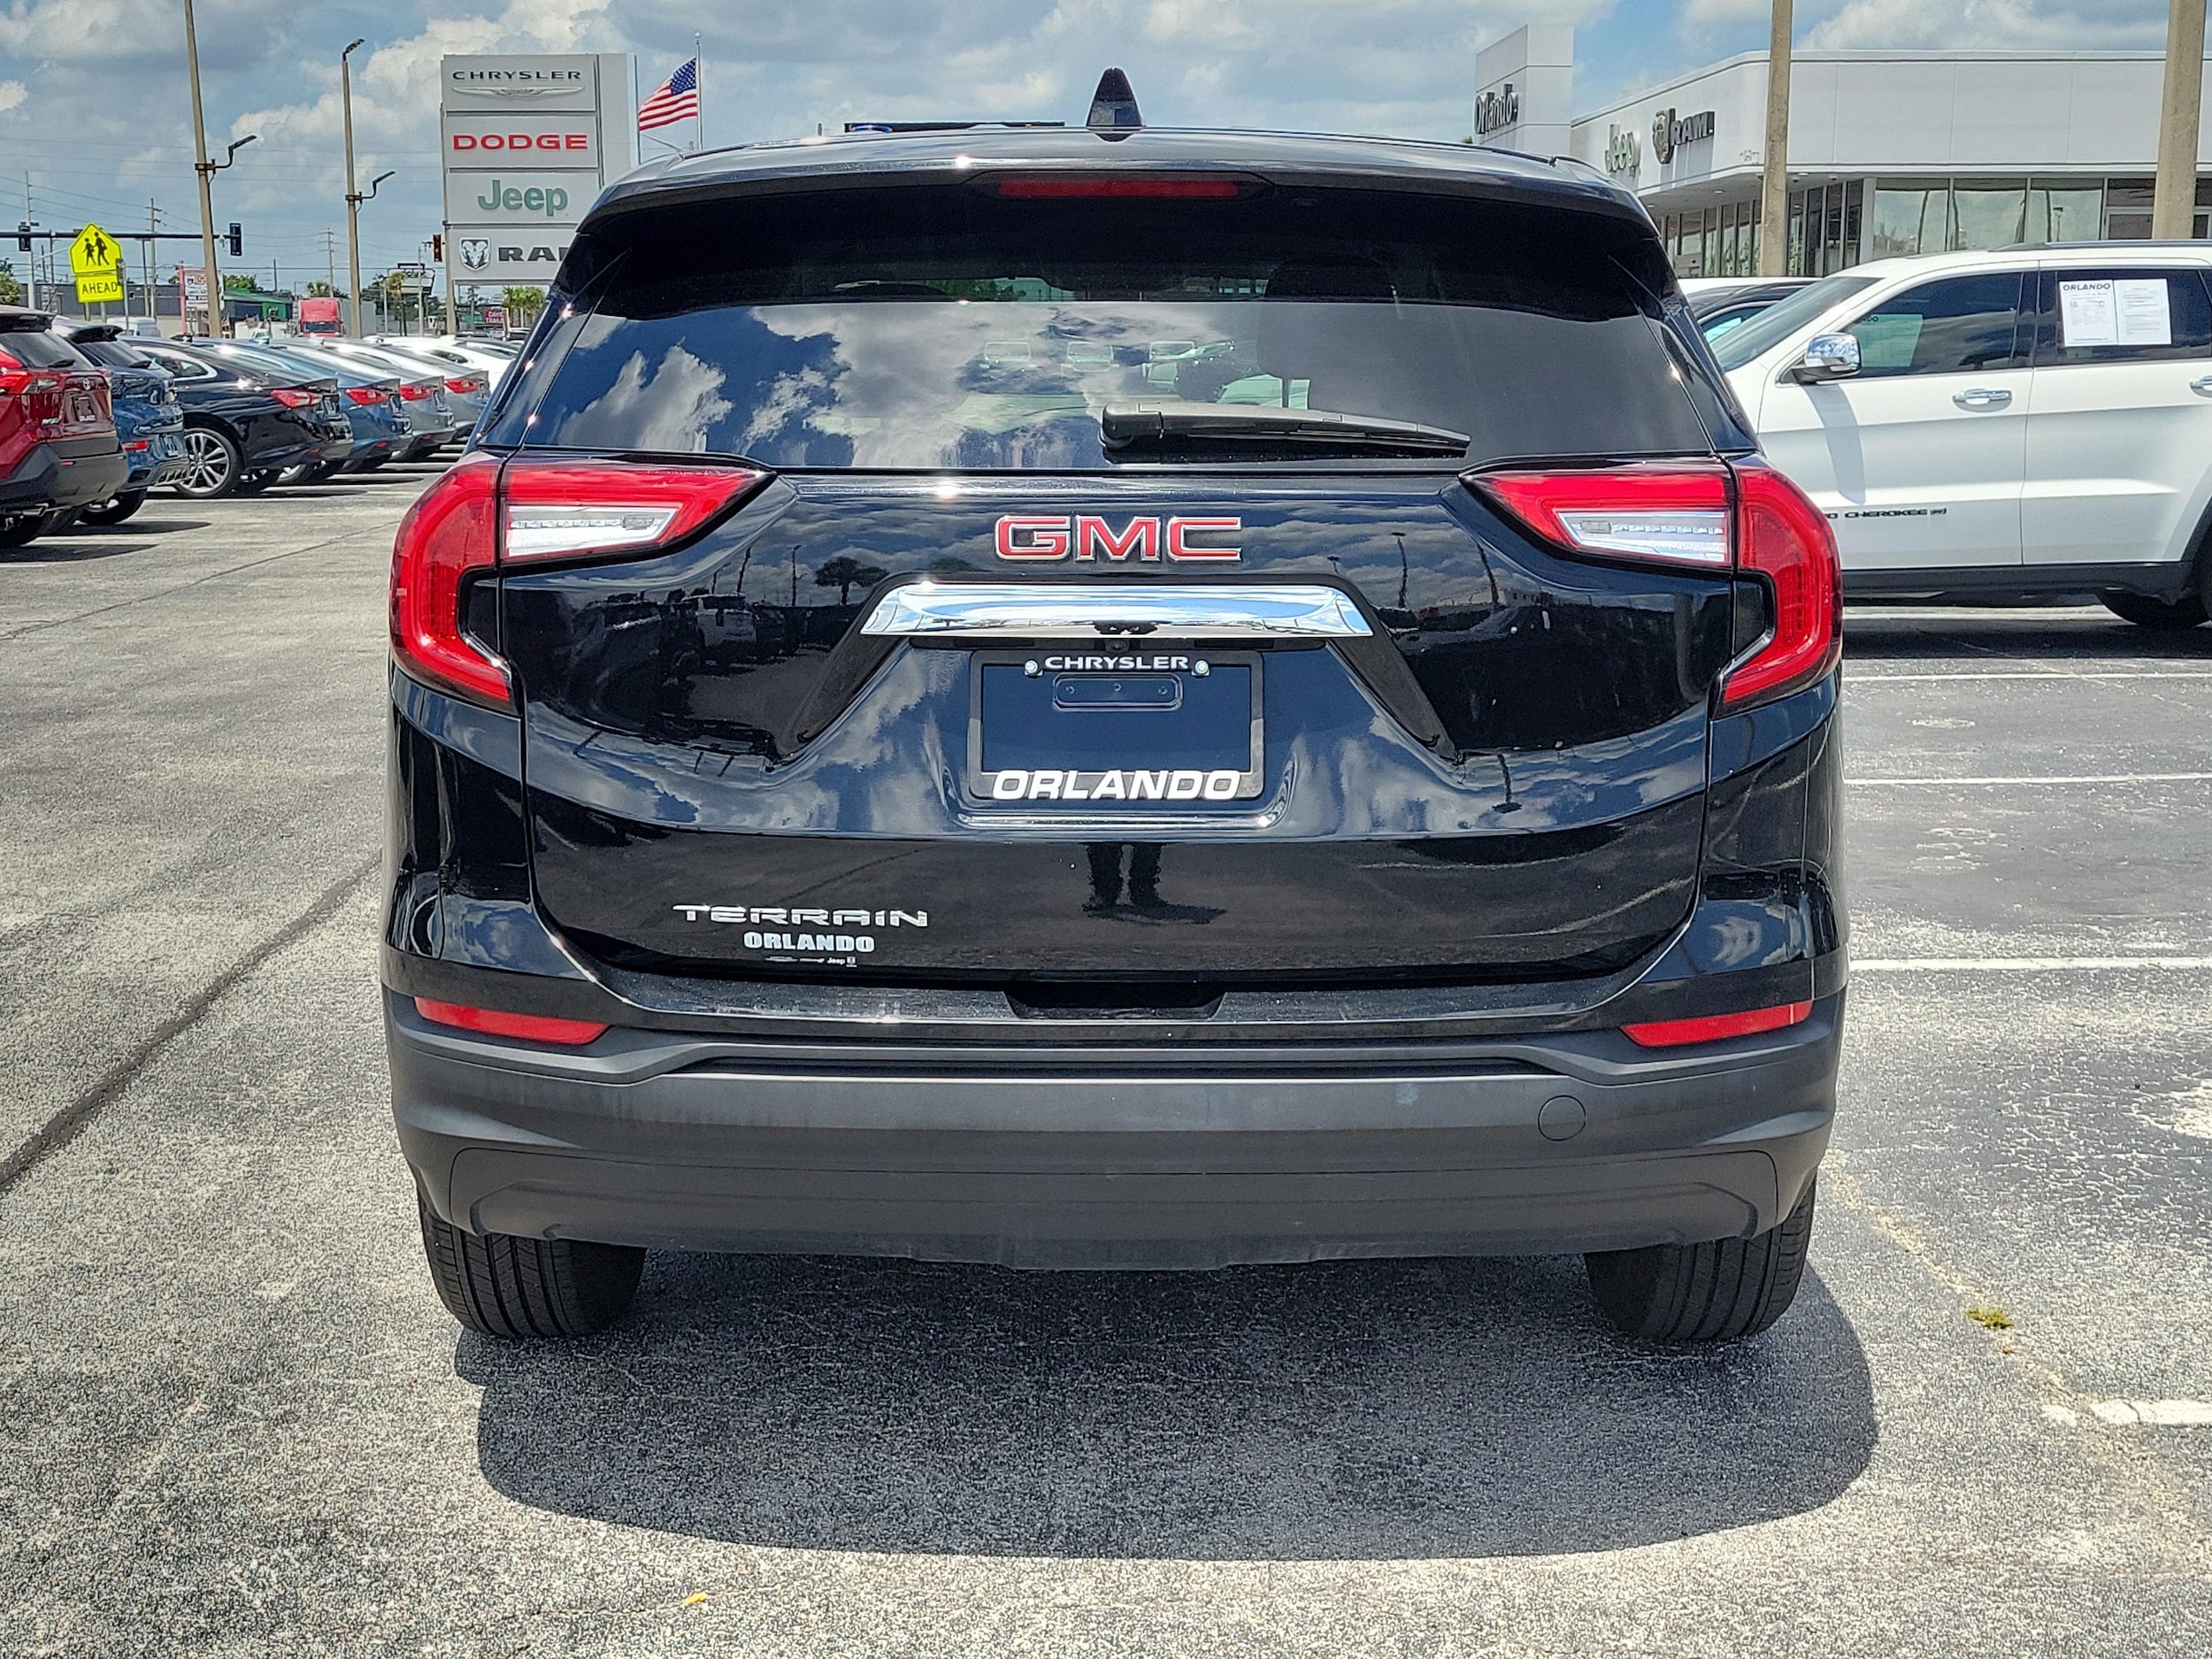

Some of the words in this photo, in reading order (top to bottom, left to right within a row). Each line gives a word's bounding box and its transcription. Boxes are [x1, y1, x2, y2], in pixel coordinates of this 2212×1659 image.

[452, 71, 581, 81] CHRYSLER
[1671, 111, 1715, 147] RAM
[453, 134, 588, 150] DODGE
[1605, 124, 1640, 178] Jeep
[478, 180, 568, 216] Jeep
[82, 281, 118, 295] AHEAD
[1845, 509, 1928, 518] CHEROKEE
[995, 515, 1241, 561] GMC
[1044, 656, 1189, 670] CHRYSLER
[992, 770, 1240, 800] ORLANDO
[672, 904, 928, 927] TERRAIN
[743, 931, 875, 952] ORLANDO
